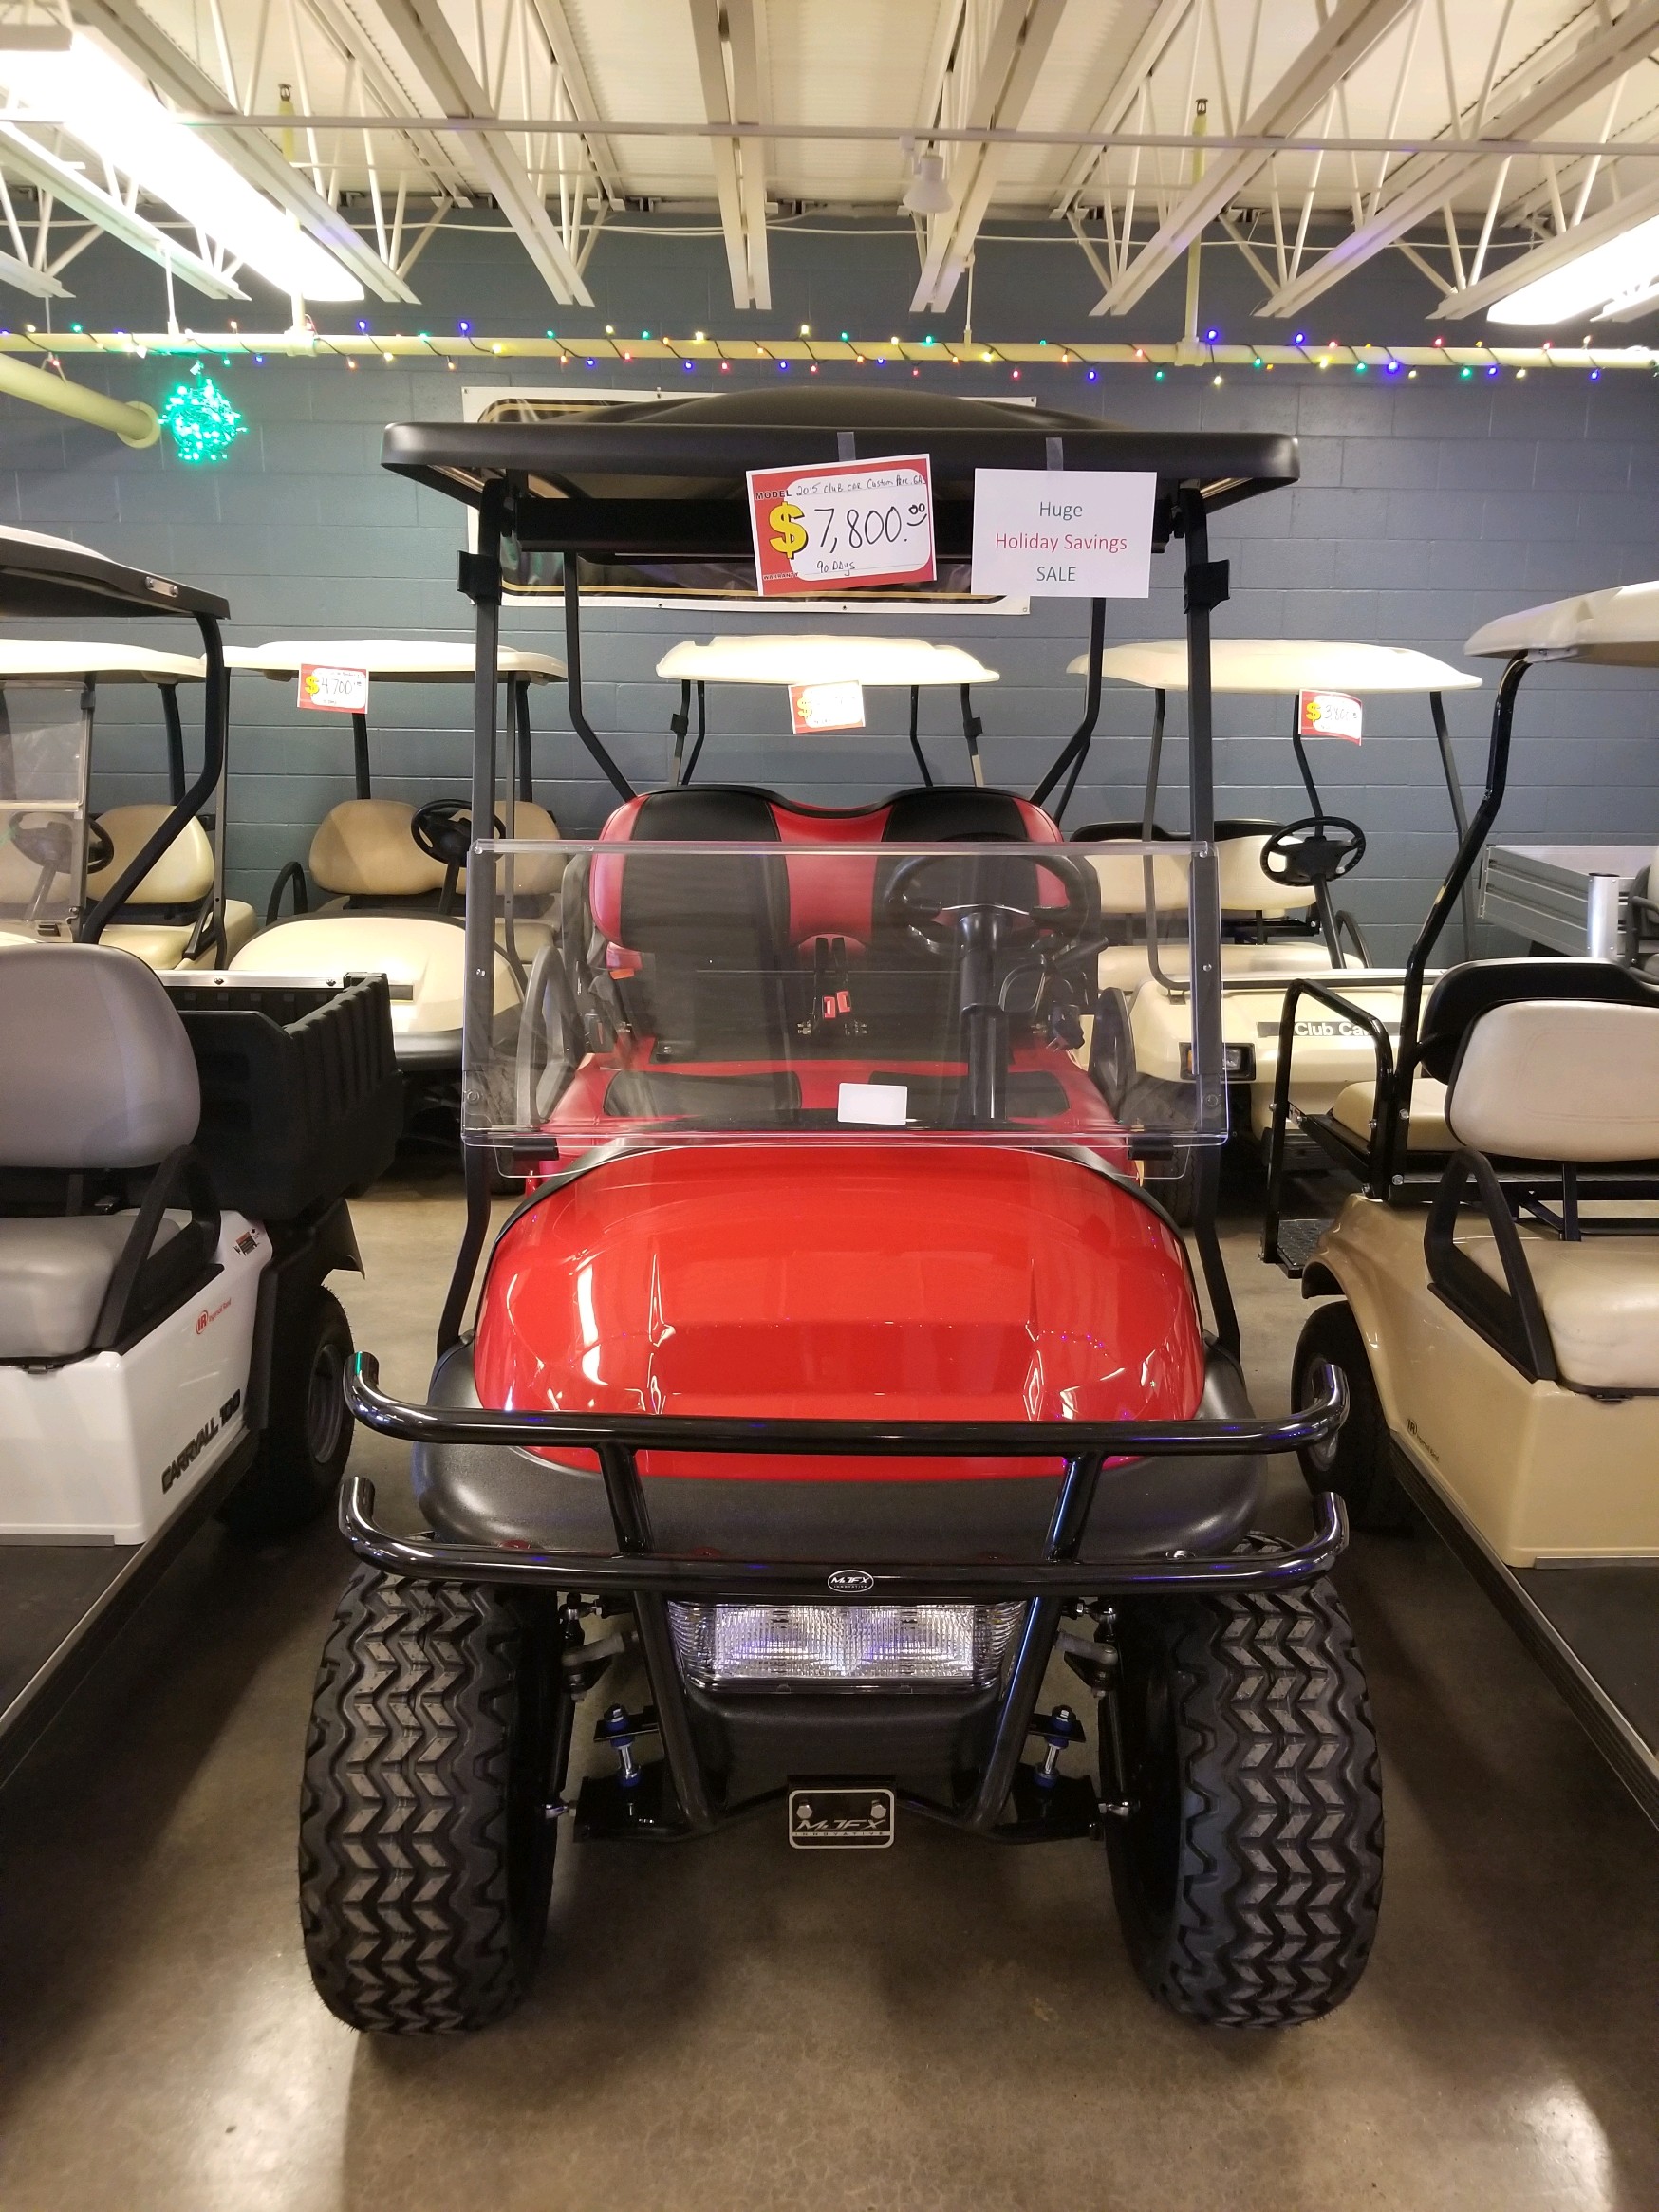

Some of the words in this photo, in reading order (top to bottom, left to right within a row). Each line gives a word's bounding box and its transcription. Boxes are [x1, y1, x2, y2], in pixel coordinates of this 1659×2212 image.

[755, 490, 792, 501] MODEL
[796, 482, 821, 495] 2015
[867, 478, 893, 489] Custom
[1039, 501, 1083, 521] Huge
[996, 532, 1059, 553] Holiday
[1064, 534, 1128, 553] Savings
[763, 571, 799, 580] WARRANTY
[817, 560, 829, 573] 90
[1036, 566, 1076, 582] SALE
[1294, 1022, 1333, 1036] Club
[161, 1417, 219, 1495] CARRYALL
